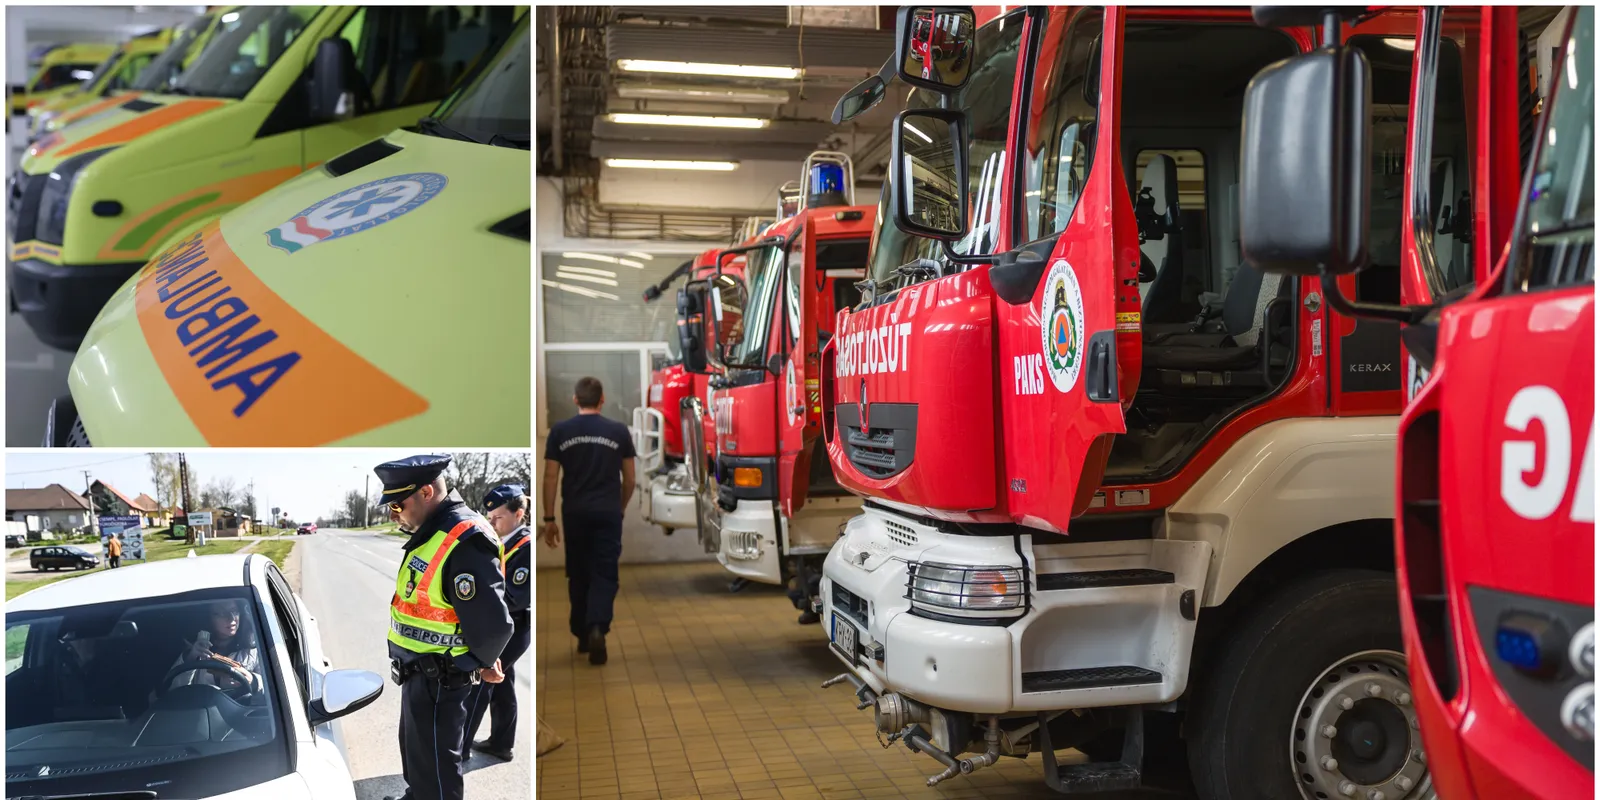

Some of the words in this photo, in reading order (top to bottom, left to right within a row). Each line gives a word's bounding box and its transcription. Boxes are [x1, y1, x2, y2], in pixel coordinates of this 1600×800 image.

[1014, 353, 1045, 395] PAKS
[1349, 363, 1392, 373] KERAX
[410, 557, 427, 572] POLICE
